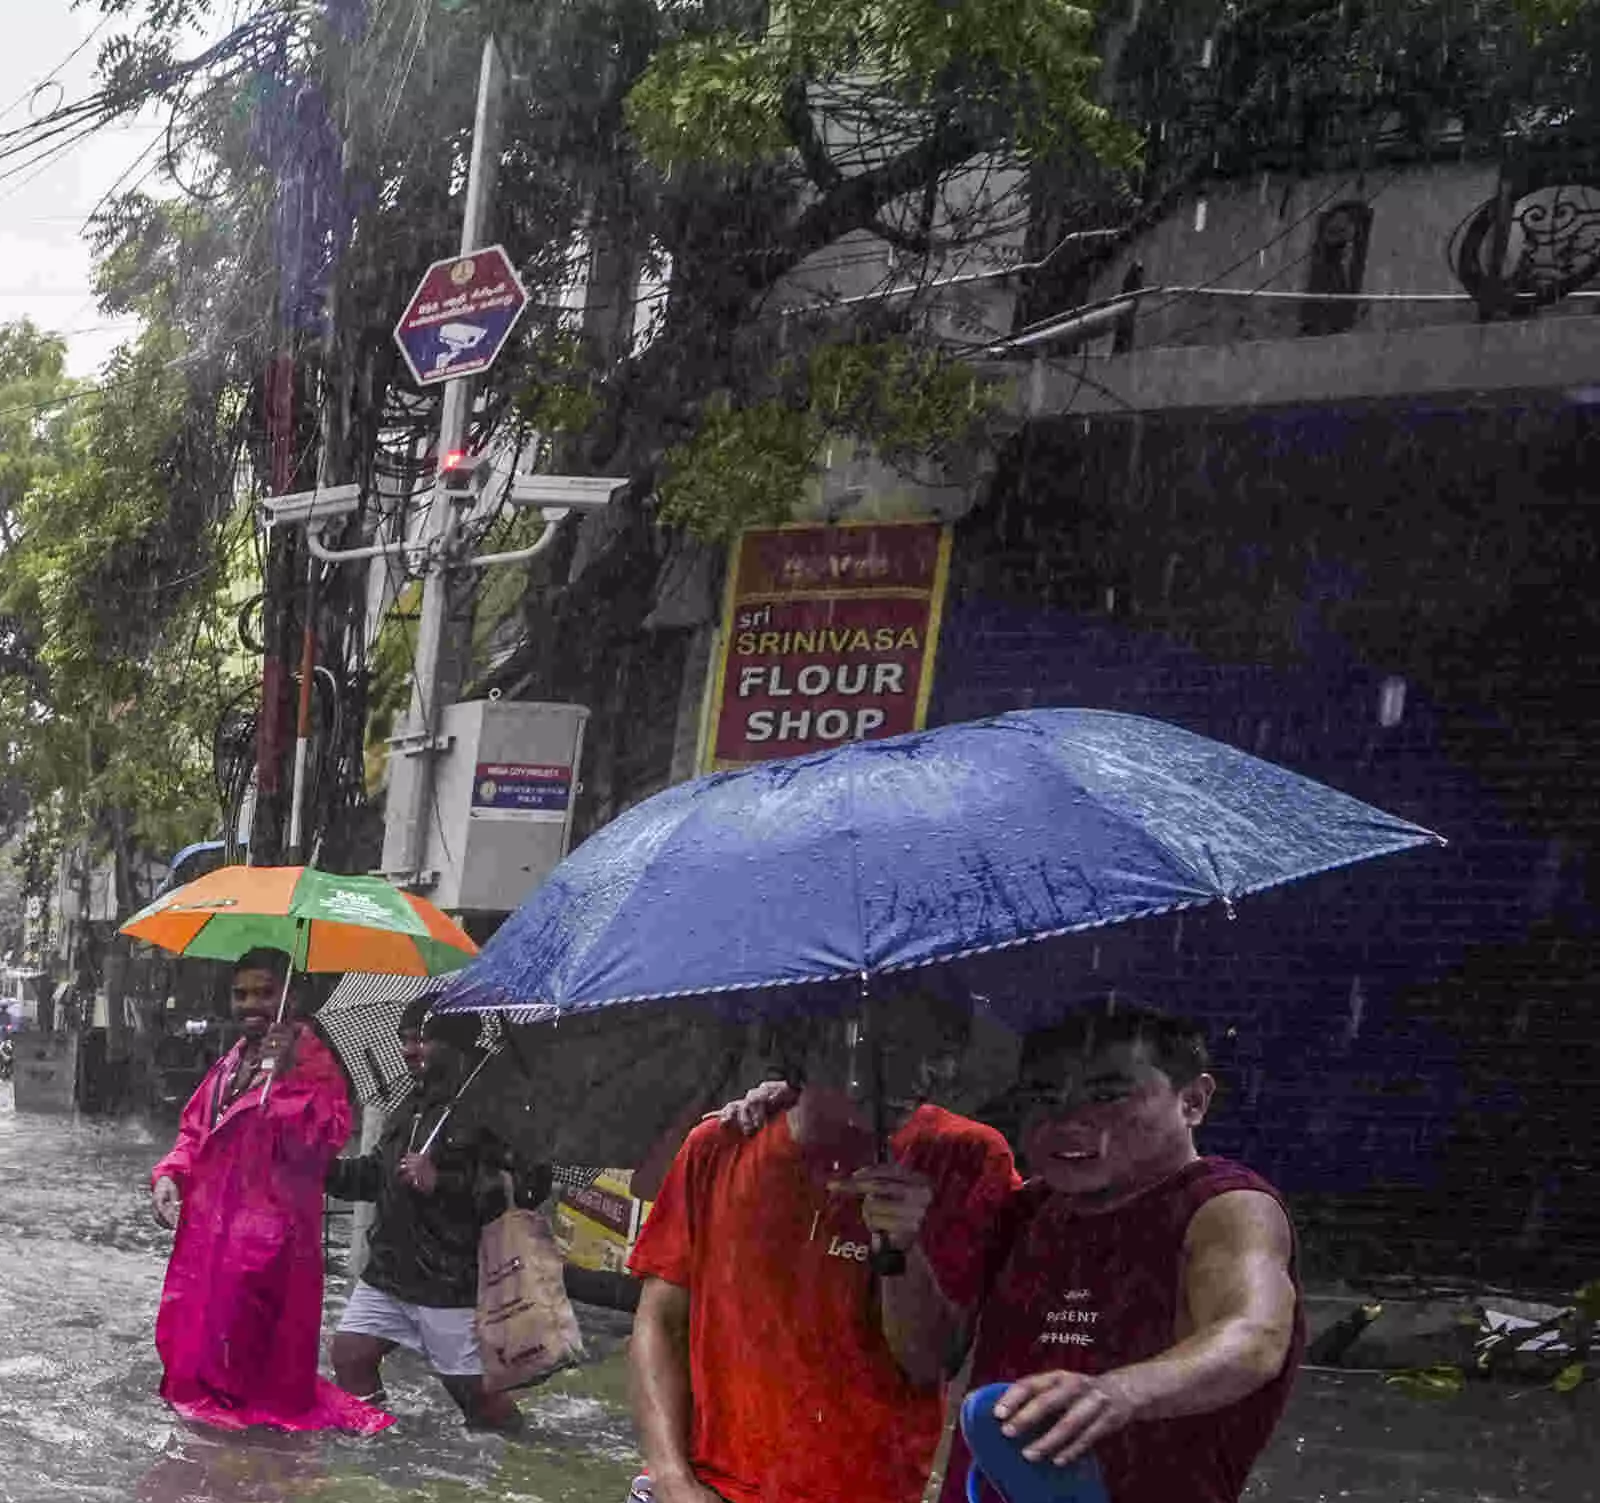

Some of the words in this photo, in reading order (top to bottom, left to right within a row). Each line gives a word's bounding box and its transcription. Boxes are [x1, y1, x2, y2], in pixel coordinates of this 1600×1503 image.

[736, 626, 919, 656] SRINIVASA
[738, 662, 904, 698] FLOUR
[744, 708, 886, 742] SHOP
[827, 1235, 870, 1262] Lee
